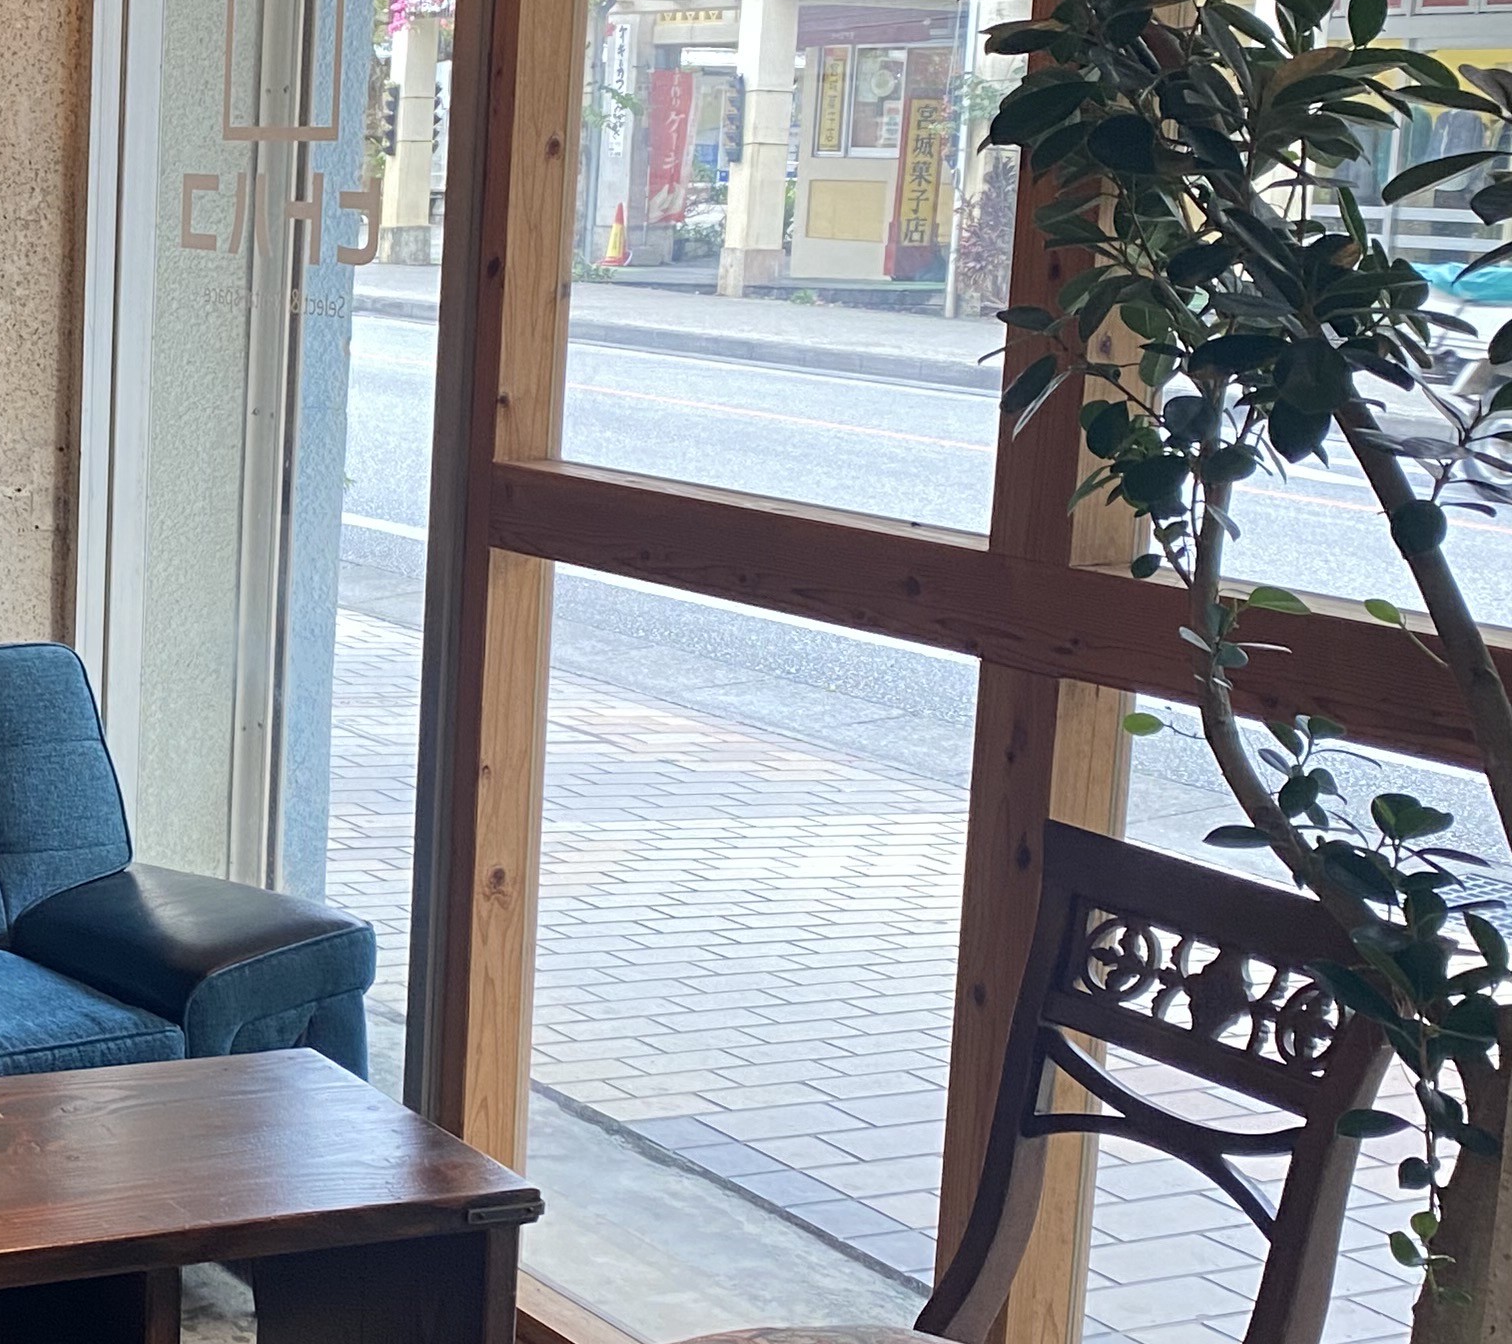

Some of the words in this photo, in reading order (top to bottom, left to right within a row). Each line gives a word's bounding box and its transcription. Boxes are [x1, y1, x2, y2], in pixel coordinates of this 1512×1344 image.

[903, 105, 938, 244] 宮城菓子店
